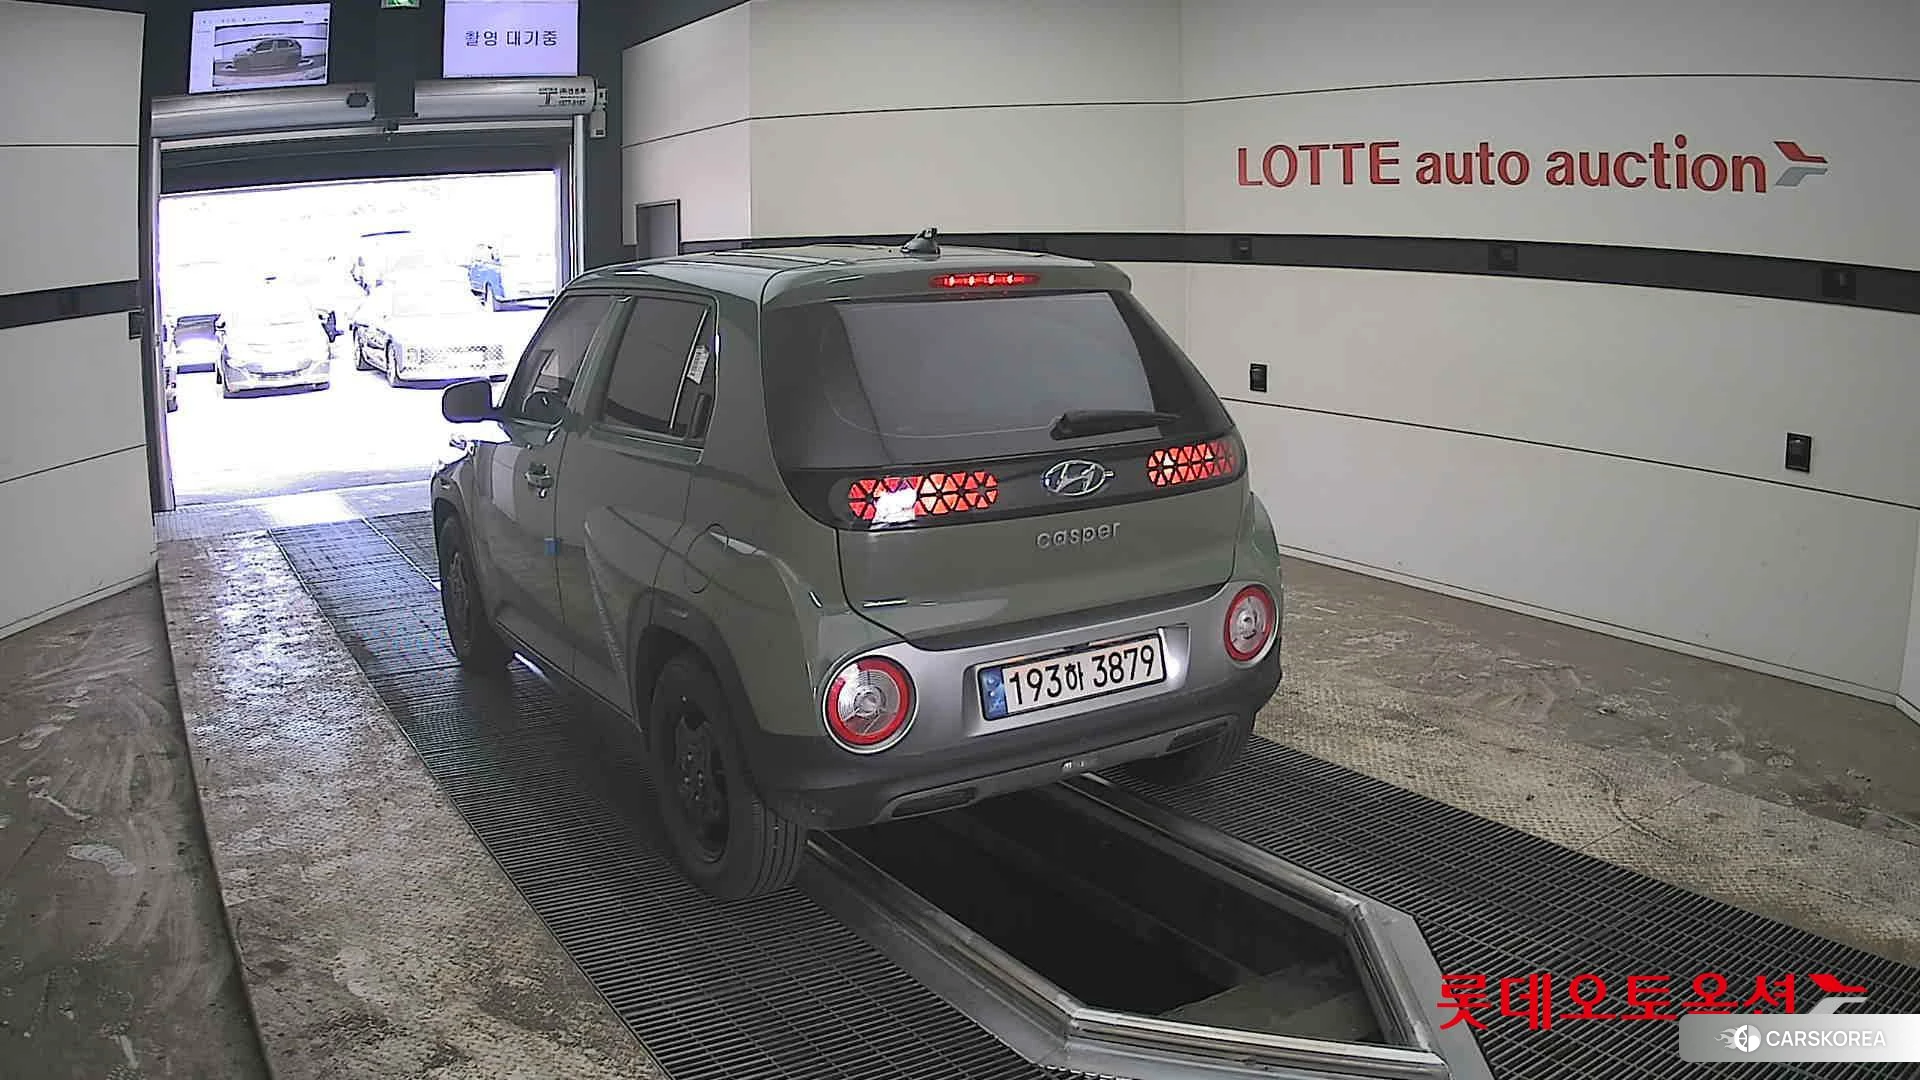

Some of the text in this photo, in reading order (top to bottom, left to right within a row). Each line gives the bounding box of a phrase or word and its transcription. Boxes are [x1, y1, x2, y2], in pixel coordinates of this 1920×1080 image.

[464, 29, 558, 47] 촬영 대기중
[1236, 134, 1768, 193] LOTTE auto auction
[1036, 521, 1121, 549] casper
[1009, 661, 1084, 705] 193하
[1091, 644, 1155, 688] 3879
